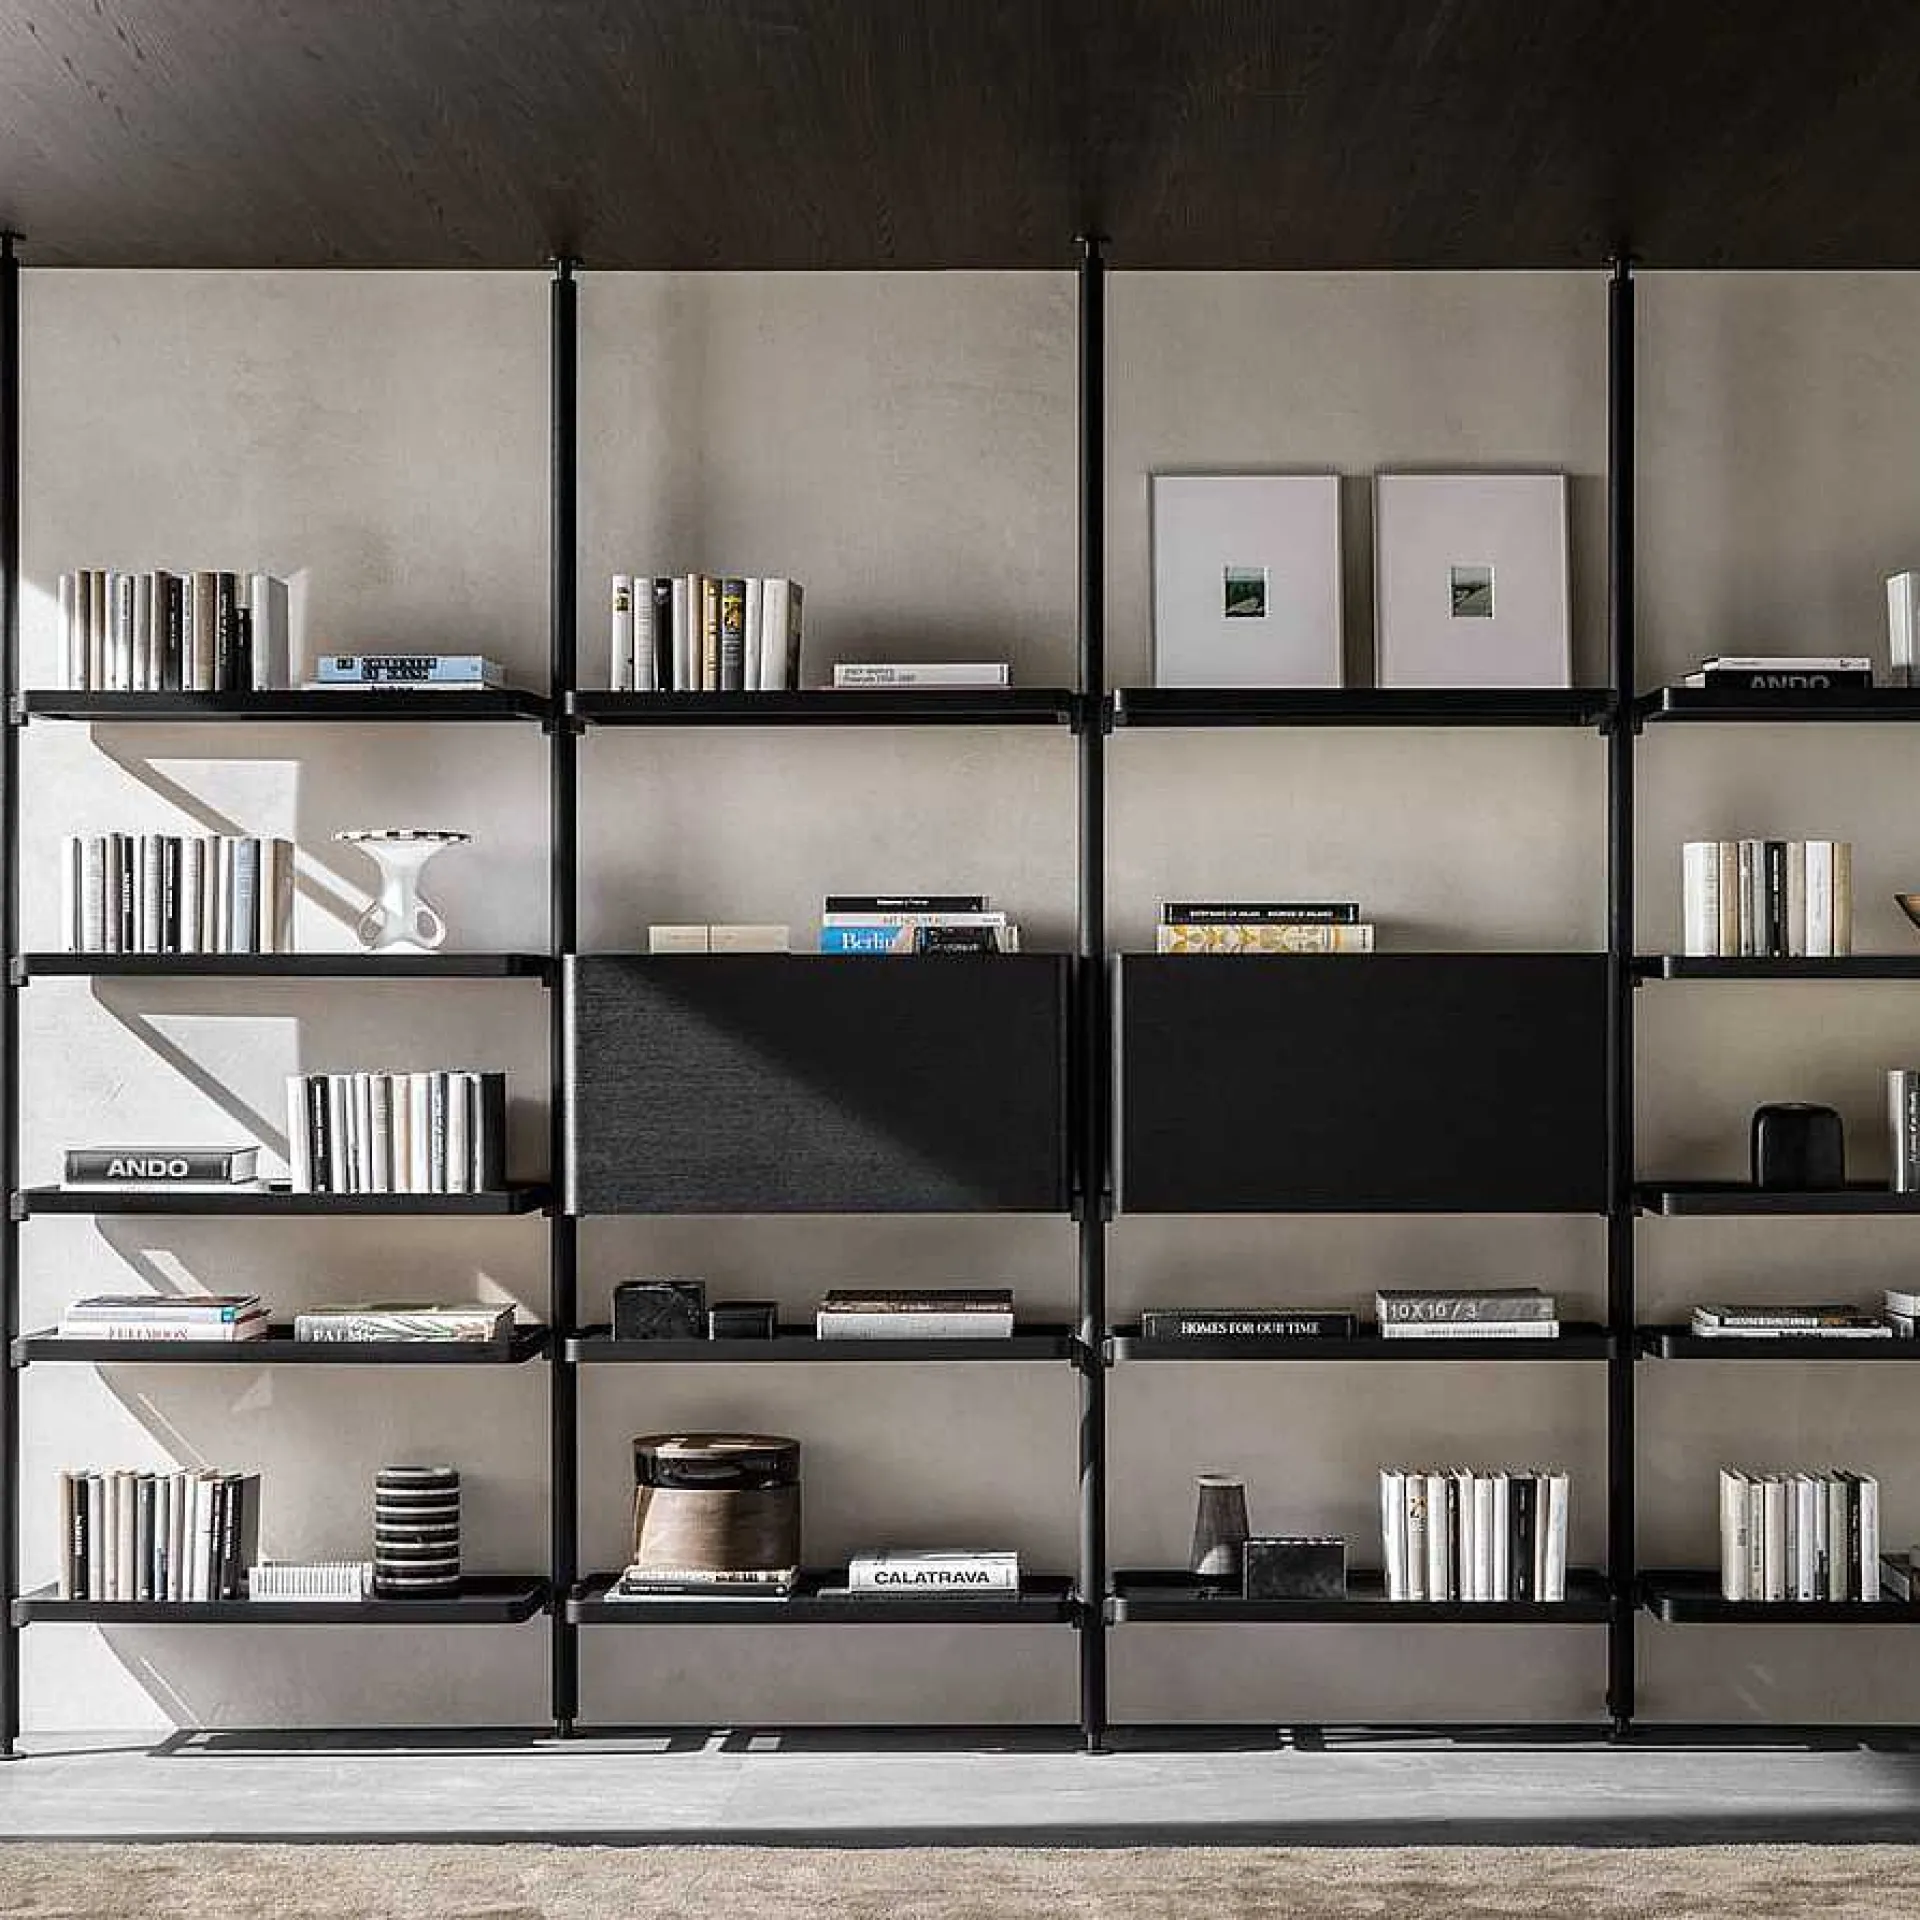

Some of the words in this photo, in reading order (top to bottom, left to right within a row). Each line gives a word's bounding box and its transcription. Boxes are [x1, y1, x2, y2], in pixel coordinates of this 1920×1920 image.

[1751, 674, 1831, 688] ANDO
[107, 1158, 189, 1177] ANDO
[1181, 1321, 1226, 1334] HOMES
[1229, 1321, 1254, 1334] FOR
[1257, 1321, 1284, 1334] OUR
[1286, 1321, 1319, 1334] TIME
[875, 1571, 989, 1585] CALATRAVA
